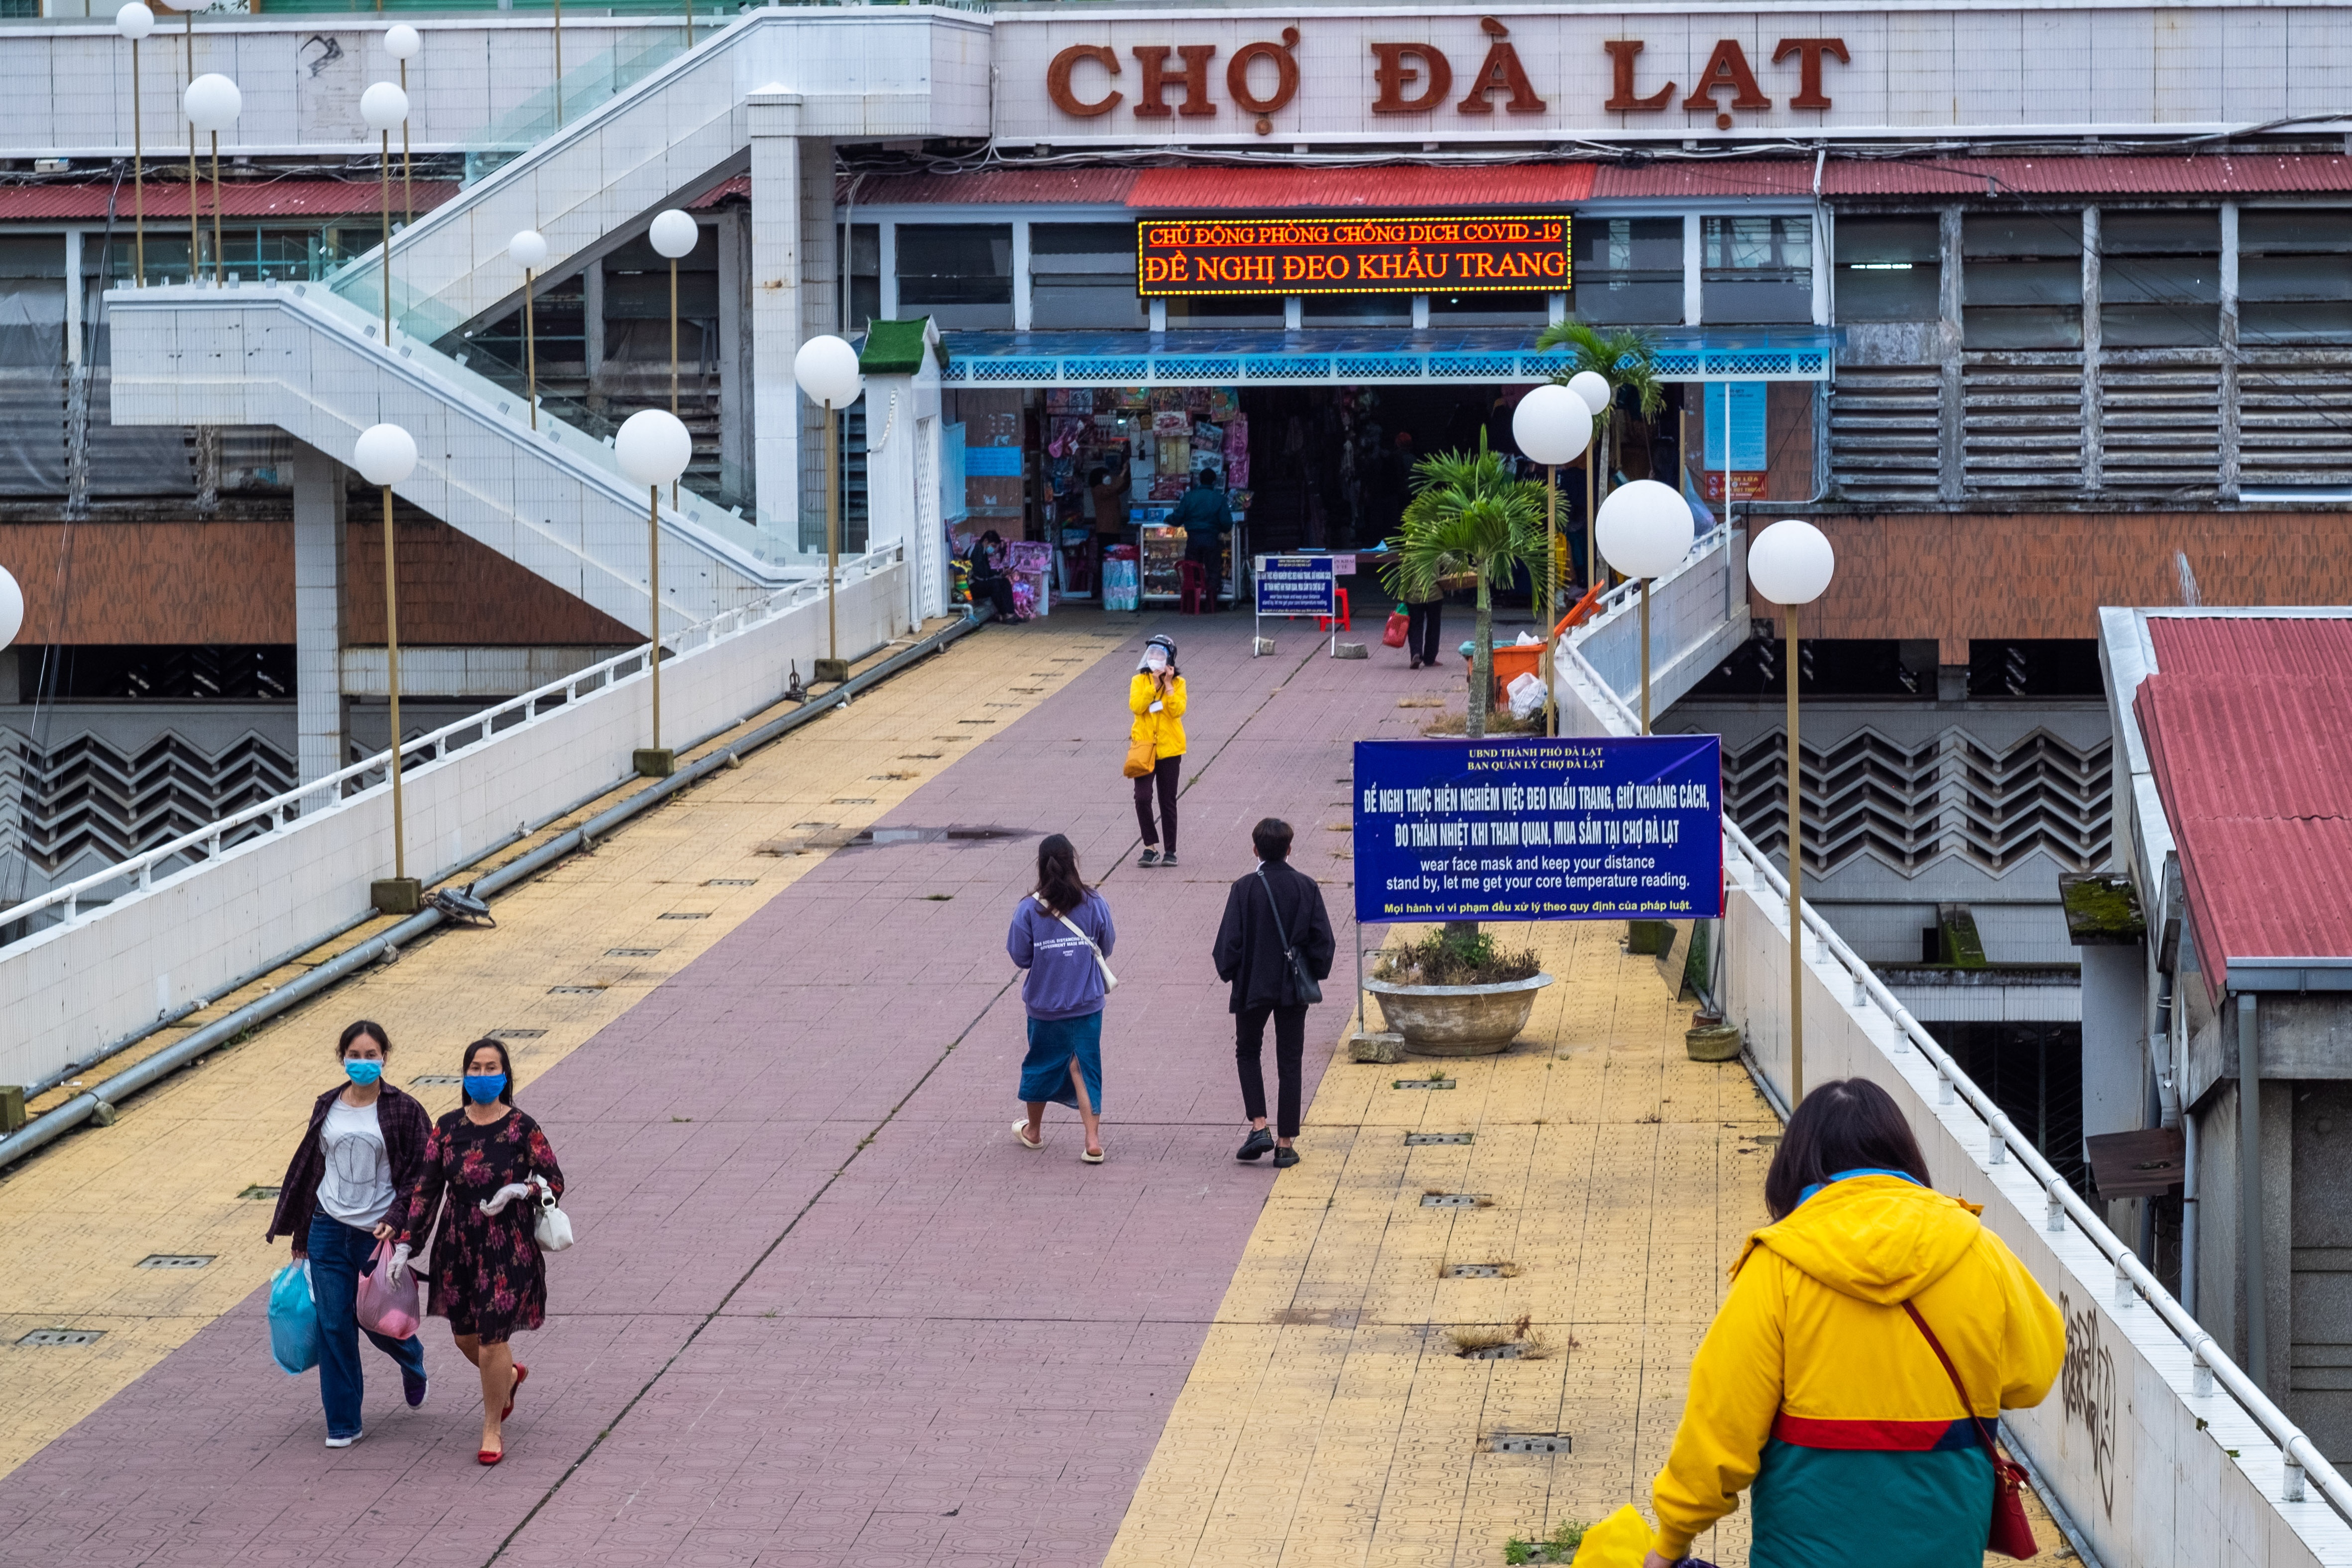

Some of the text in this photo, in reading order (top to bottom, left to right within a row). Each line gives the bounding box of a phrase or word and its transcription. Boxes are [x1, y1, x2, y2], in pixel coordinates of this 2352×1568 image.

[1047, 15, 1851, 135] CHỢ ĐÀ LẠT
[1195, 225, 1256, 245] ĐỘNG
[1258, 222, 1329, 243] PHÒNG
[1333, 222, 1406, 242] CHỐNG
[1409, 225, 1460, 242] DỊCH
[1464, 224, 1529, 240] COVID
[1145, 249, 1189, 282] ĐỀ
[1194, 255, 1276, 284] NGHỊ
[1283, 255, 1350, 281] ĐEO
[1456, 251, 1567, 278] TRANG
[1469, 745, 1603, 758] UBND THÀNH PHỐ ĐÀ LẠT
[1468, 758, 1605, 771] BAN QUẢN LÝ CHỢ ĐÀ LẠT
[1380, 789, 1404, 817] NGHỊ
[1406, 786, 1431, 817] THỰC
[1434, 783, 1458, 817] HIỆN
[1460, 782, 1500, 811] NGHIÊM
[1502, 782, 1524, 816] VIỆC
[1527, 787, 1546, 810] ĐEO
[1549, 776, 1576, 810] KHẨU
[1578, 786, 1614, 812] TRANG,
[1617, 781, 1635, 810] GIỮ
[1636, 777, 1676, 809] KHOẢNG
[1679, 779, 1710, 811] CÁCH,
[1395, 812, 1679, 851] ĐO THÂN NHIỆT KHI THAM QUAN, MUA SẮM TẠI CHỢ ĐÀ LẠT
[1420, 855, 1655, 872] wear face mask and keep your distance
[1387, 872, 1689, 893] stand by, let me get your core temperature reading.
[1384, 900, 1692, 915] Mọi hành vi vi phạm đều xử lý theo quy định của pháp luật.
